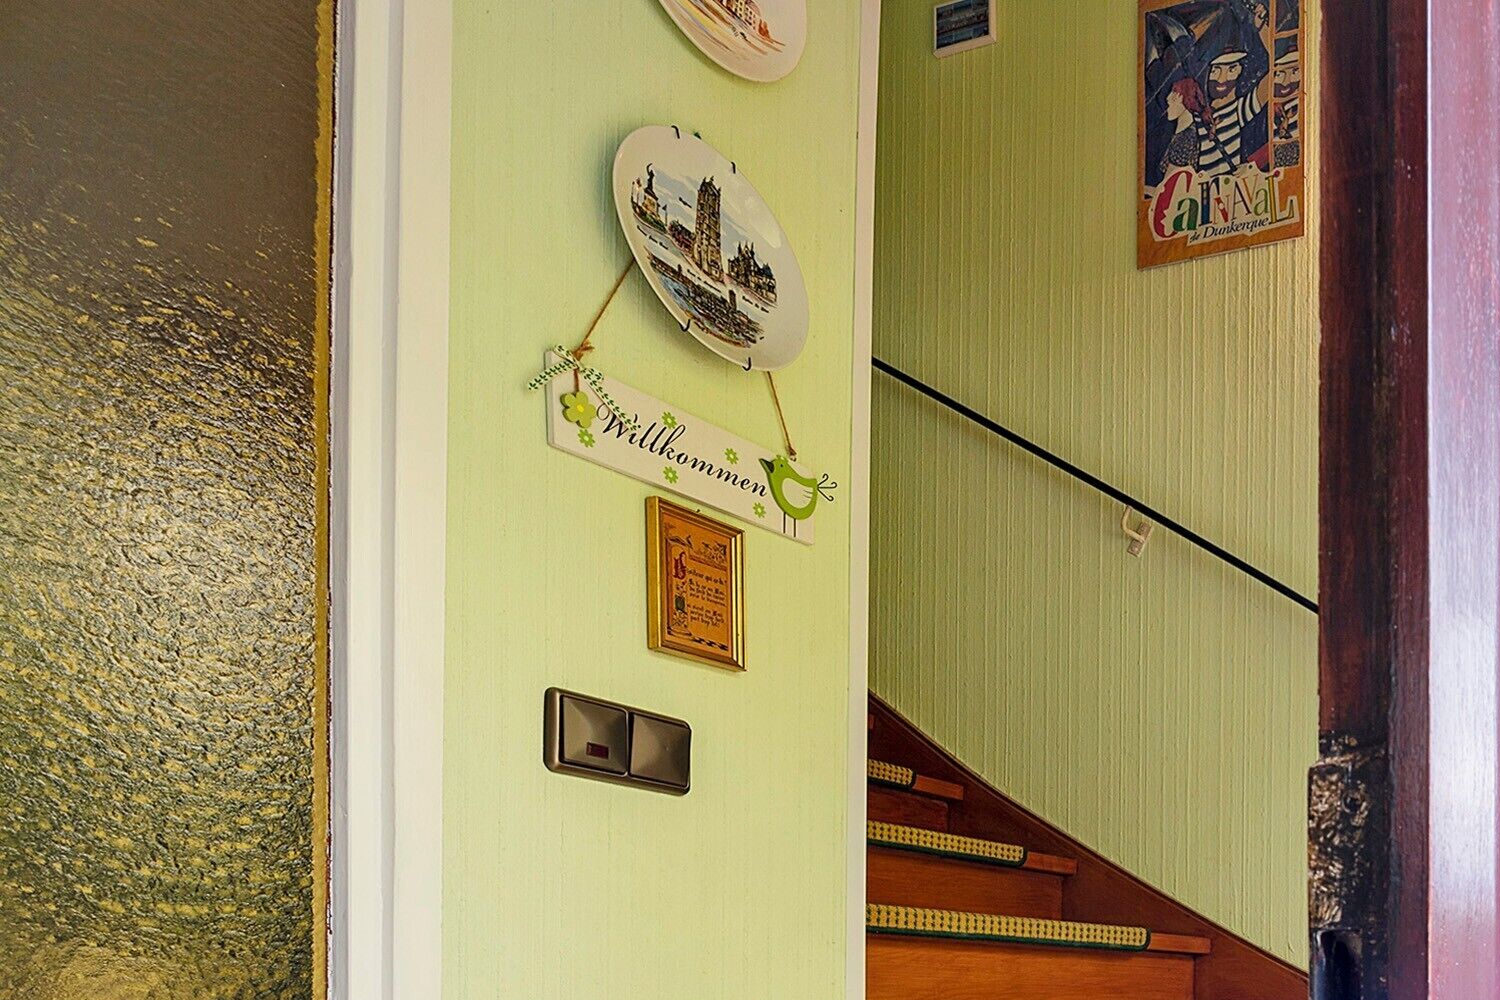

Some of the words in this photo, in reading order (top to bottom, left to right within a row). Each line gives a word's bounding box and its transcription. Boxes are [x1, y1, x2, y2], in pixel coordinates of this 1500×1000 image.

[1190, 231, 1200, 242] de
[1203, 217, 1270, 239] Dunkerque
[596, 402, 768, 498] Willkommen
